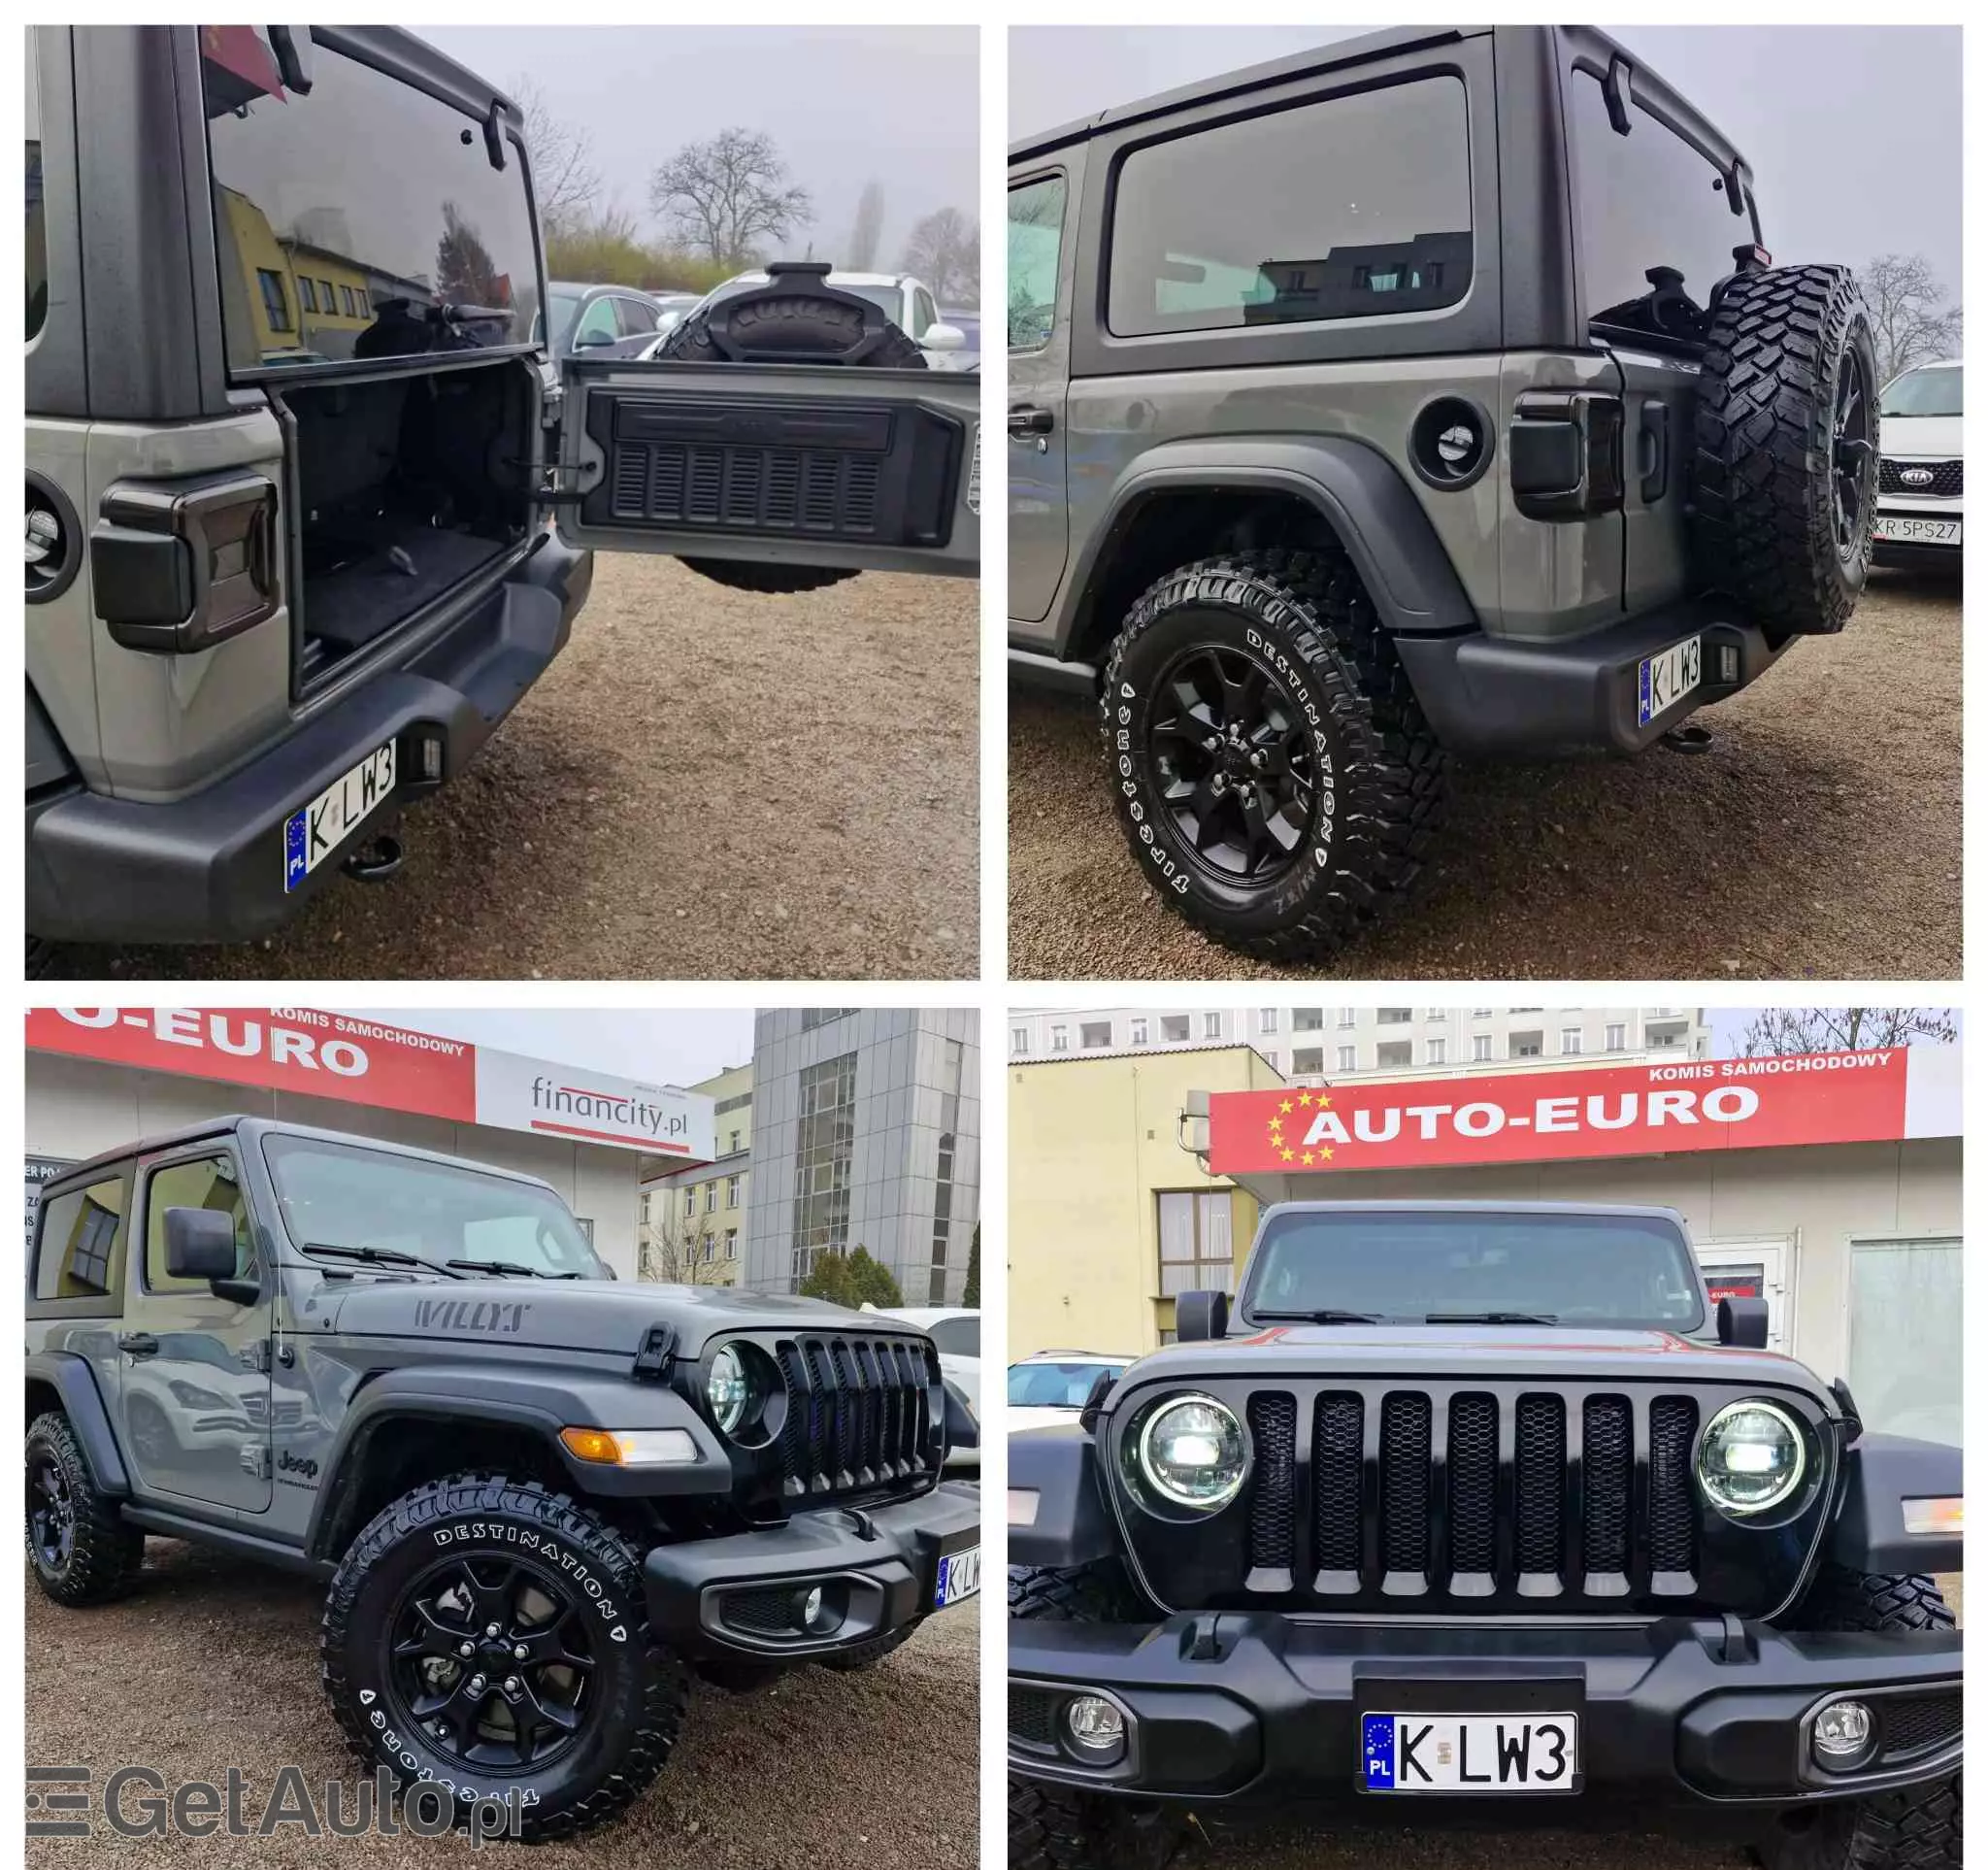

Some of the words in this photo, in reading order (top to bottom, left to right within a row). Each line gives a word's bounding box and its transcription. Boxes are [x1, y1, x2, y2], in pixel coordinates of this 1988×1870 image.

[1905, 472, 1928, 483] KIA
[1874, 519, 1896, 536] KR
[1903, 520, 1957, 540] 5PS27
[1652, 659, 1664, 712] K
[1245, 628, 1335, 844] DESTINATION
[1117, 705, 1190, 894] Firestone
[310, 797, 329, 864] K
[290, 854, 305, 877] PL
[270, 1008, 329, 1028] KOMIS
[334, 1018, 464, 1056] SAMOCHODOWY
[1648, 1064, 1714, 1082] KOMIS
[1721, 1052, 1892, 1077] SAMOCHODOWY
[532, 1077, 687, 1136] financity.pl
[1302, 1085, 1759, 1146] AUTO-EURO
[414, 1300, 531, 1332] WILLYS
[278, 1450, 318, 1479] Jeep
[433, 1523, 617, 1620] DESTINATION
[1369, 1759, 1391, 1776] PL
[1400, 1724, 1434, 1782] K
[1459, 1723, 1567, 1783] LW3
